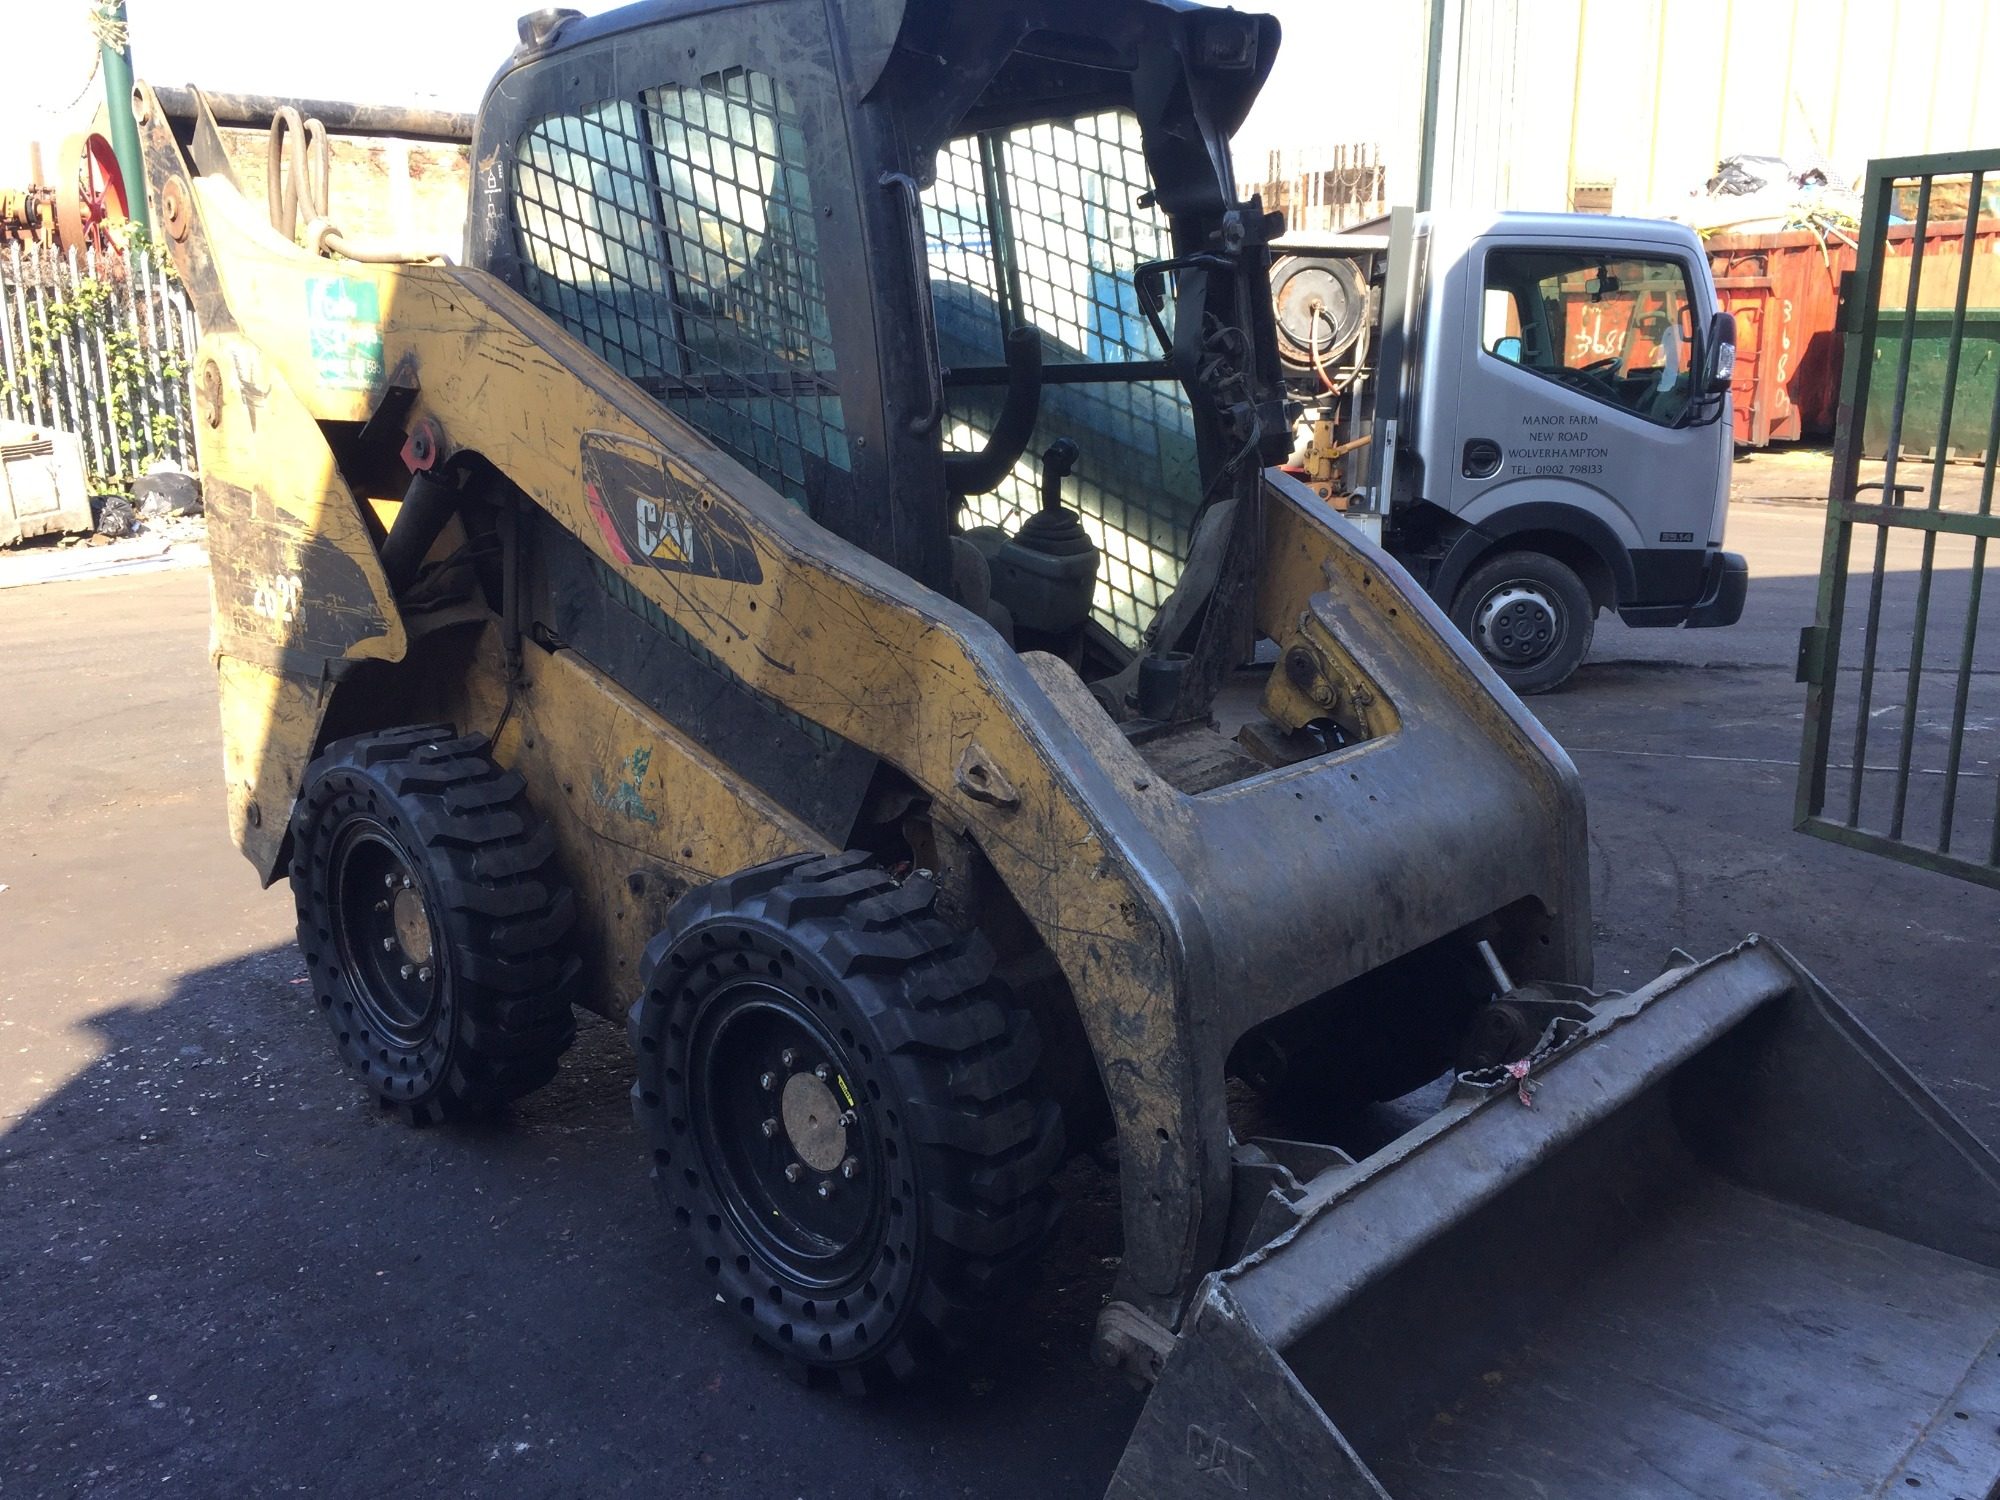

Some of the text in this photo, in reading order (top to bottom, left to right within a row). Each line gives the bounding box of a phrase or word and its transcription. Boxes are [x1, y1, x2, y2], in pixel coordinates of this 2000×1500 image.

[1522, 415, 1598, 425] MANOR FARM
[1529, 432, 1588, 442] NEW ROAD
[1508, 448, 1608, 458] WOLVERHAMPTON
[1535, 465, 1563, 475] 01902
[1569, 465, 1603, 475] 798133
